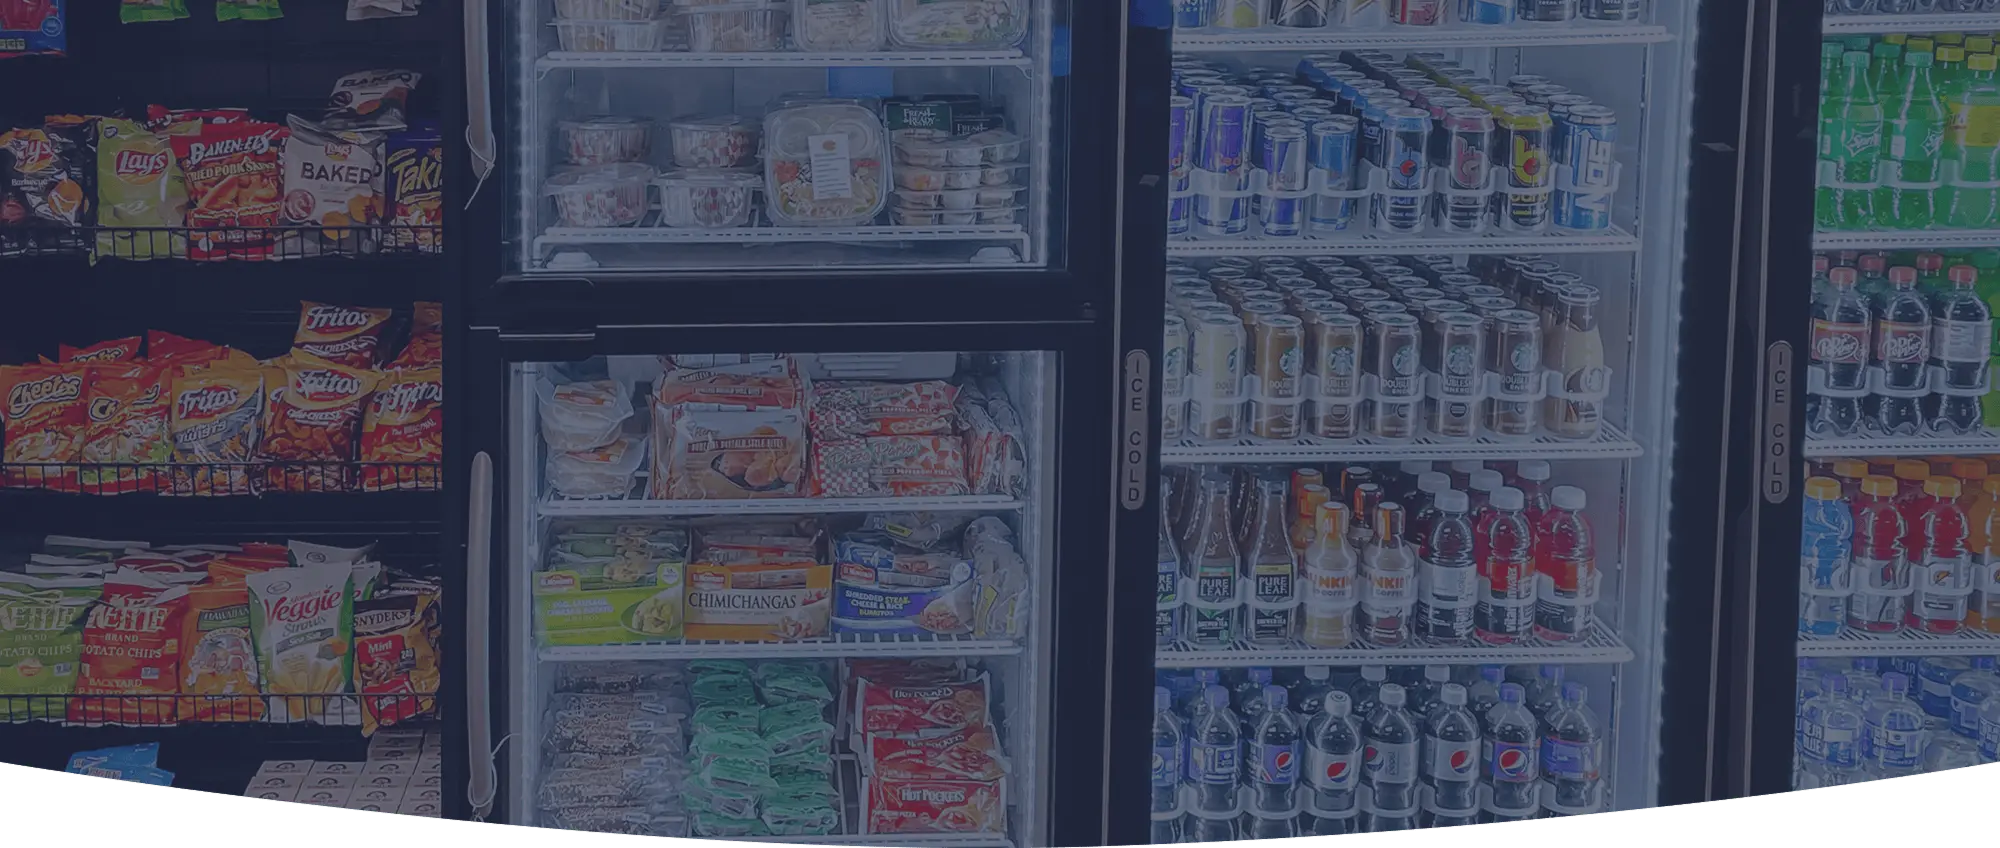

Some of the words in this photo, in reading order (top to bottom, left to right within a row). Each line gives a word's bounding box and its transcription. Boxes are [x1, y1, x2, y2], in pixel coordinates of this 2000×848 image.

[301, 161, 373, 185] BAKED
[306, 305, 369, 330] Fritos
[1774, 351, 1786, 403] ICE
[1131, 359, 1143, 411] ICE
[8, 374, 82, 418] Cheetos
[178, 387, 237, 420] Fritos
[1771, 424, 1785, 494] COLD
[1128, 431, 1141, 502] COLD
[1200, 578, 1229, 588] PURE
[1258, 576, 1288, 587] PURE
[845, 589, 884, 602] SHREDDED
[1200, 587, 1230, 597] LEAF
[1258, 585, 1288, 596] LEAF
[688, 592, 796, 610] CHIMICHANGAS
[850, 599, 879, 609] CHEESE
[264, 589, 342, 628] Veggie
[104, 633, 139, 644] BRAND
[38, 644, 73, 657] CHIPS
[128, 646, 163, 660] CHIPS
[89, 677, 143, 690] BACKYARD
[901, 788, 922, 801] HOT
[922, 788, 966, 802] POCKETS
